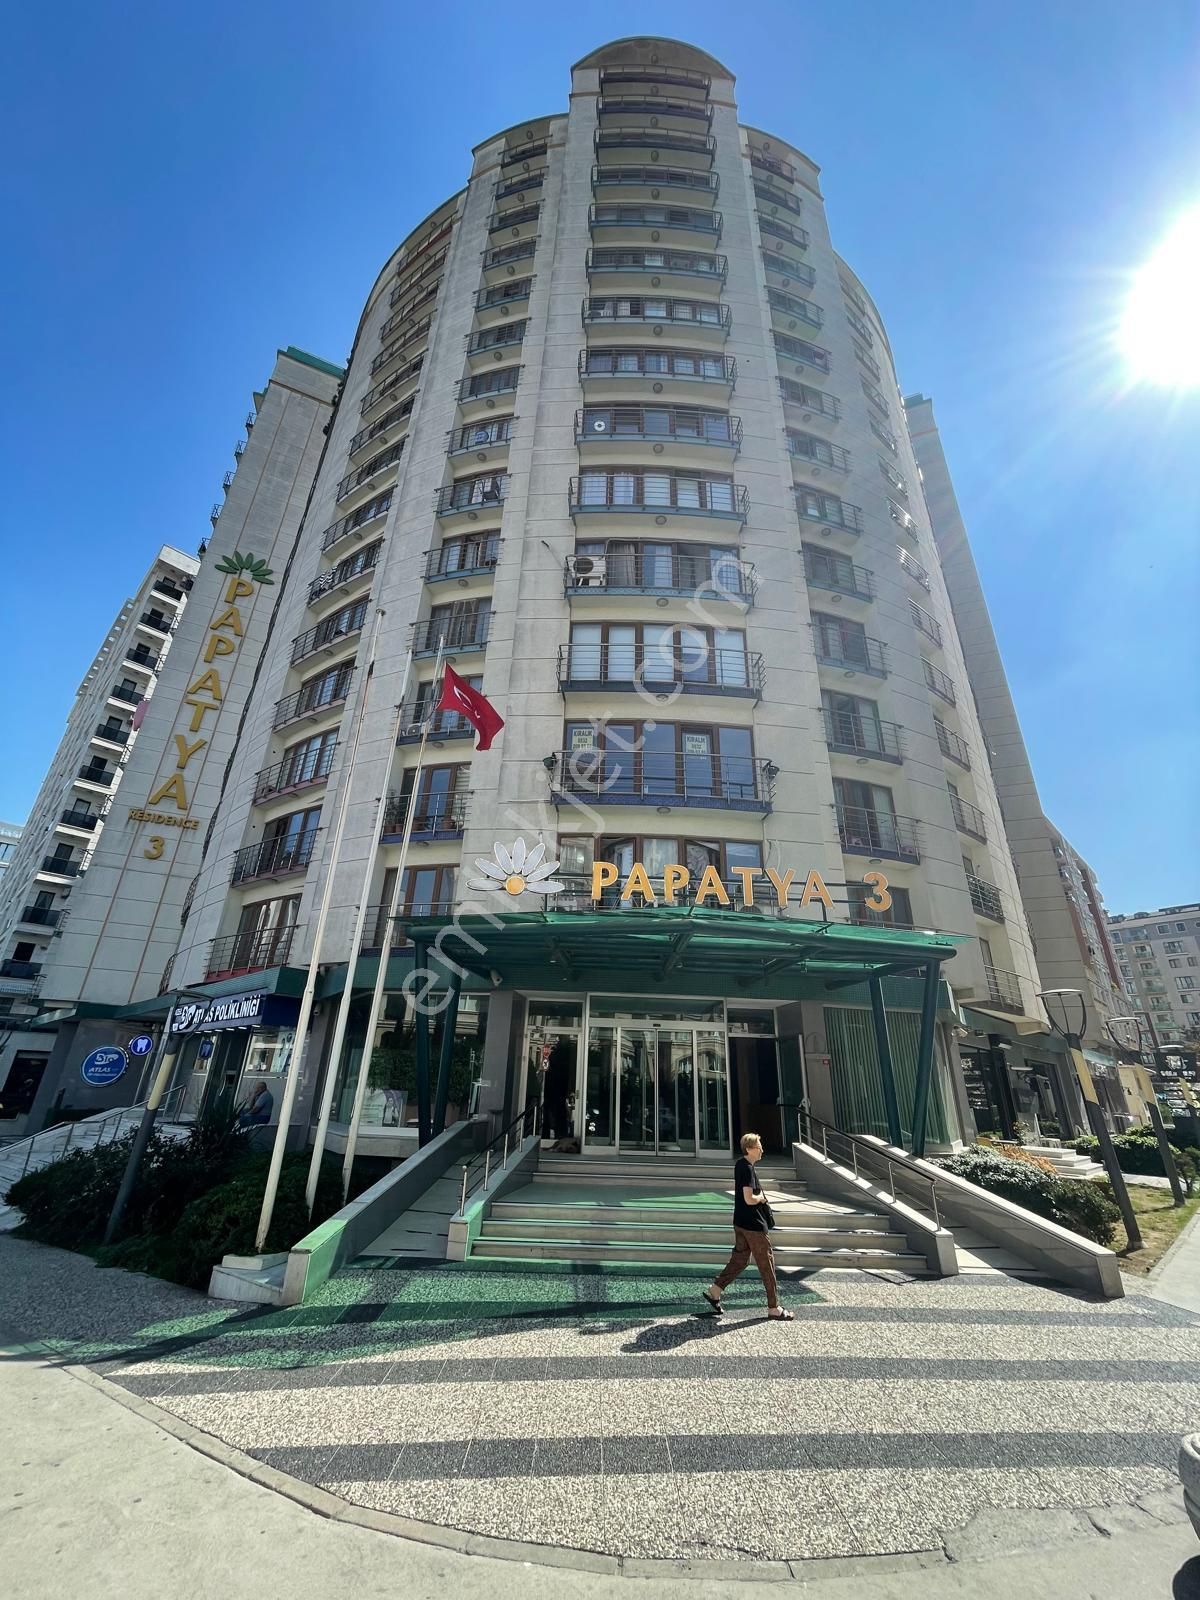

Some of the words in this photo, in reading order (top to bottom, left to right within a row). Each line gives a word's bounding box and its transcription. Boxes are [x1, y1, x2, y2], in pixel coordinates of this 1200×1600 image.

[148, 577, 254, 811] PAPATYA
[128, 808, 200, 830] RESIDENCE
[144, 835, 165, 860] 3
[591, 860, 835, 910] PAPATYA
[864, 870, 893, 913] 3
[214, 994, 261, 1021] POLİKLİNİĞİ
